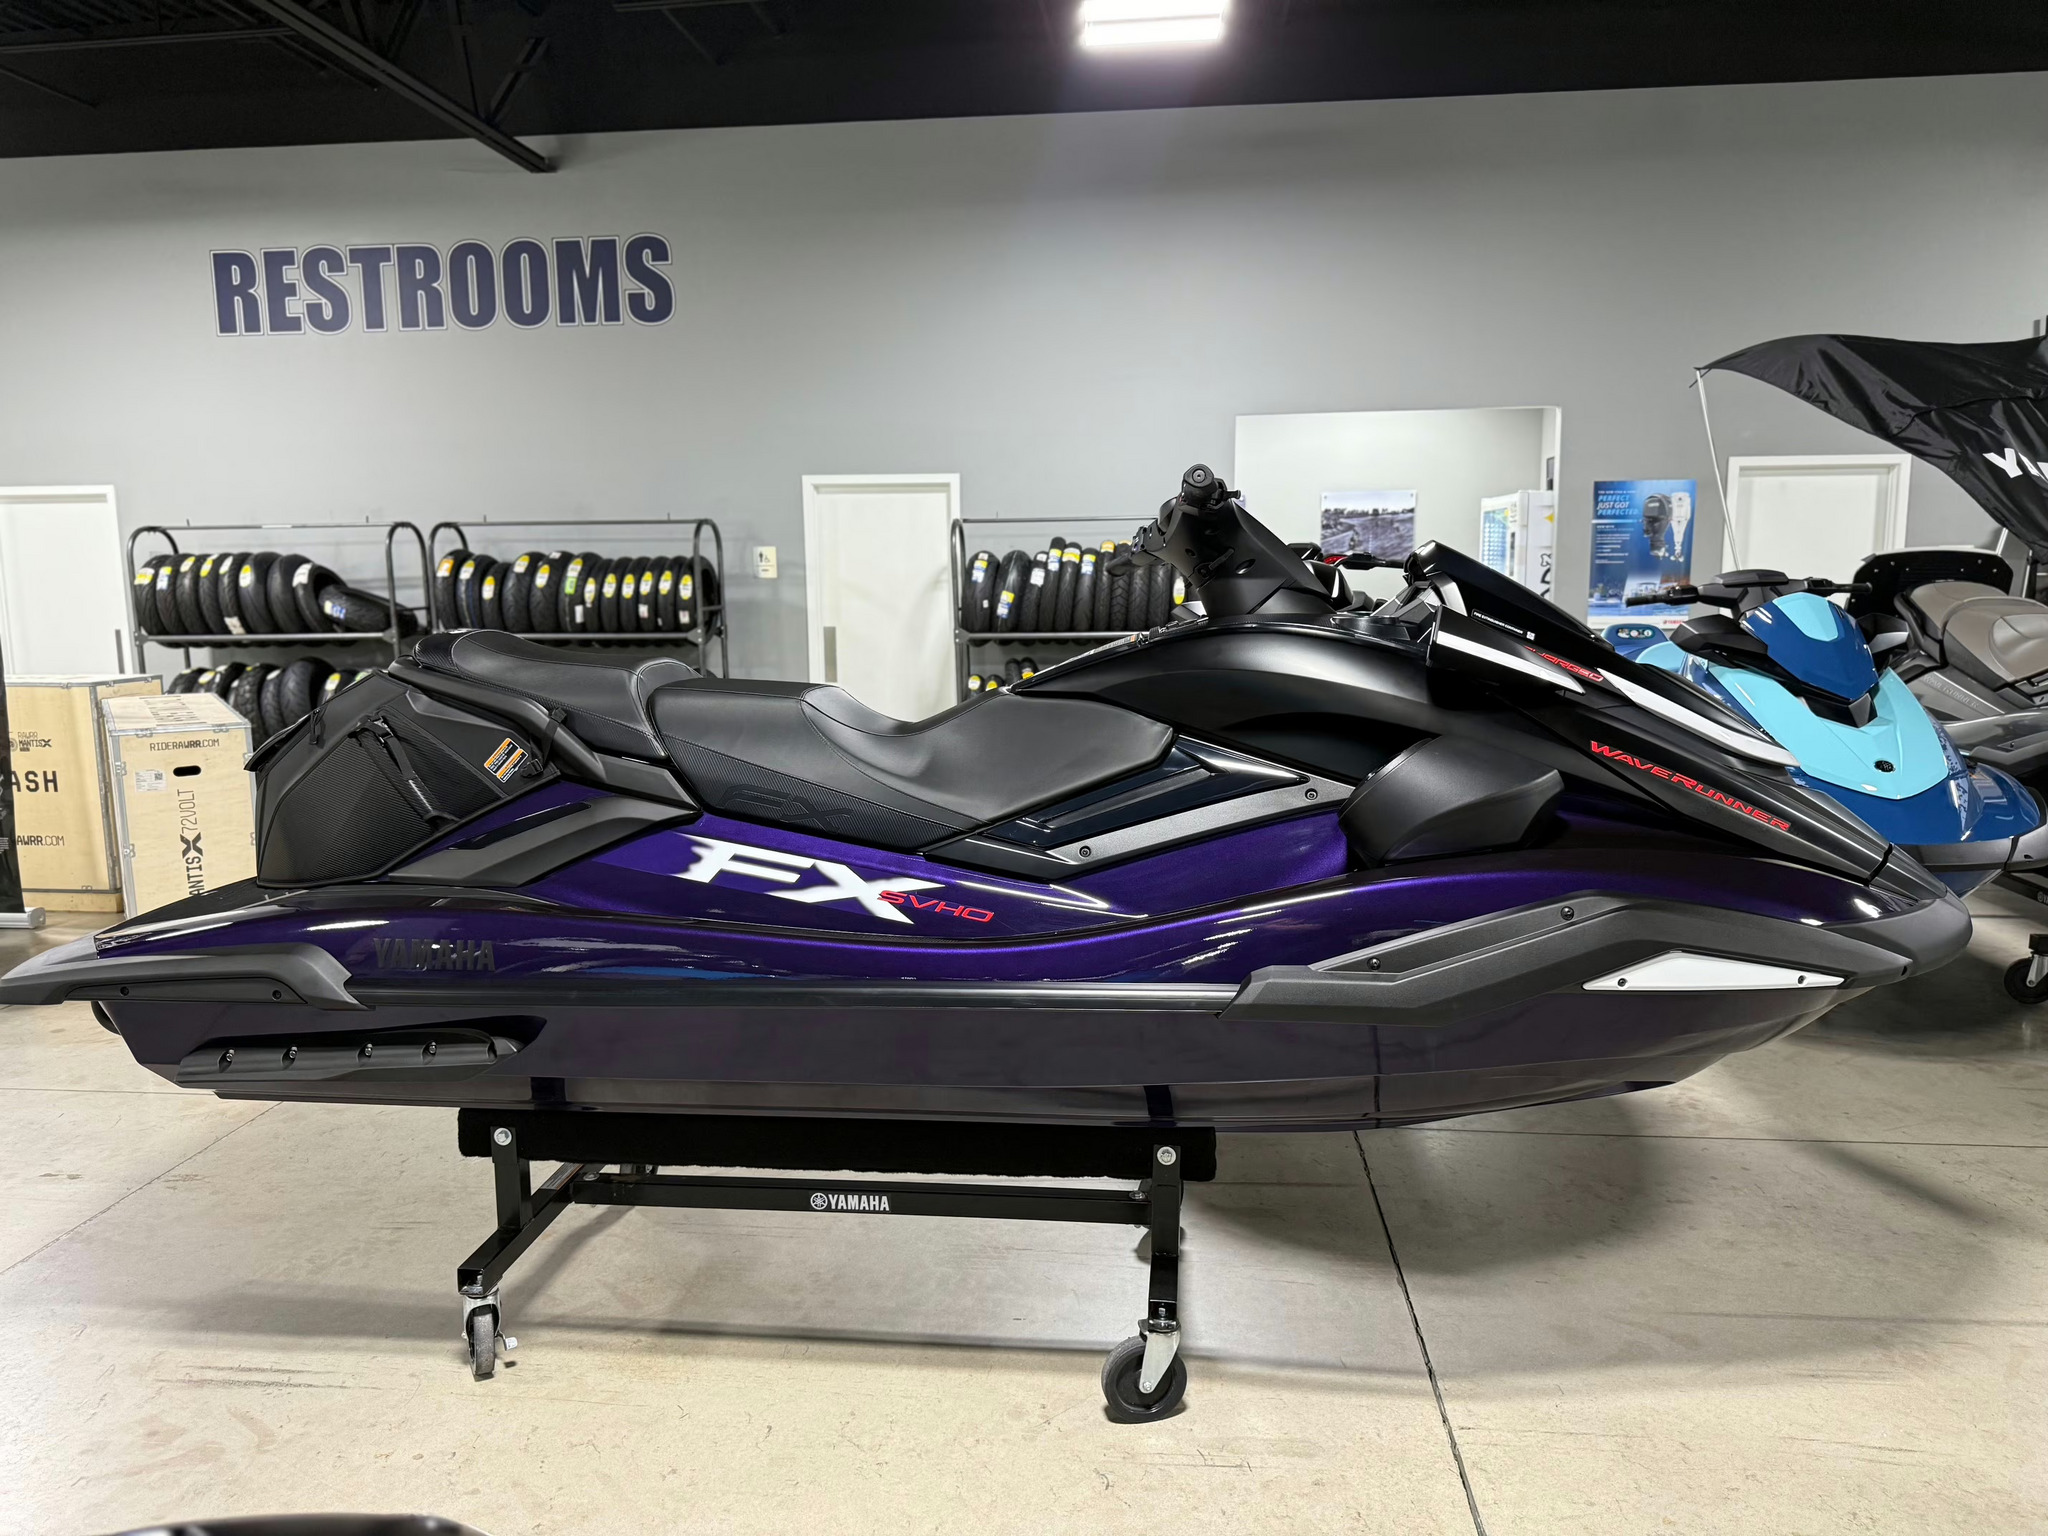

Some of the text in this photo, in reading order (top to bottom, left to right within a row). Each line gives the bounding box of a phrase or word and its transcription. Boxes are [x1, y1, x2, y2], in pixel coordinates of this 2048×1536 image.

[210, 232, 676, 336] RESTROOMS
[1597, 501, 1630, 510] JUST GOT
[150, 738, 220, 752] RIDERAWRR.COM
[1590, 740, 1791, 832] WAVERUNNER
[669, 832, 995, 925] FX SVHO
[373, 937, 497, 972] YAMAHA
[828, 1194, 890, 1211] YAMAHA
